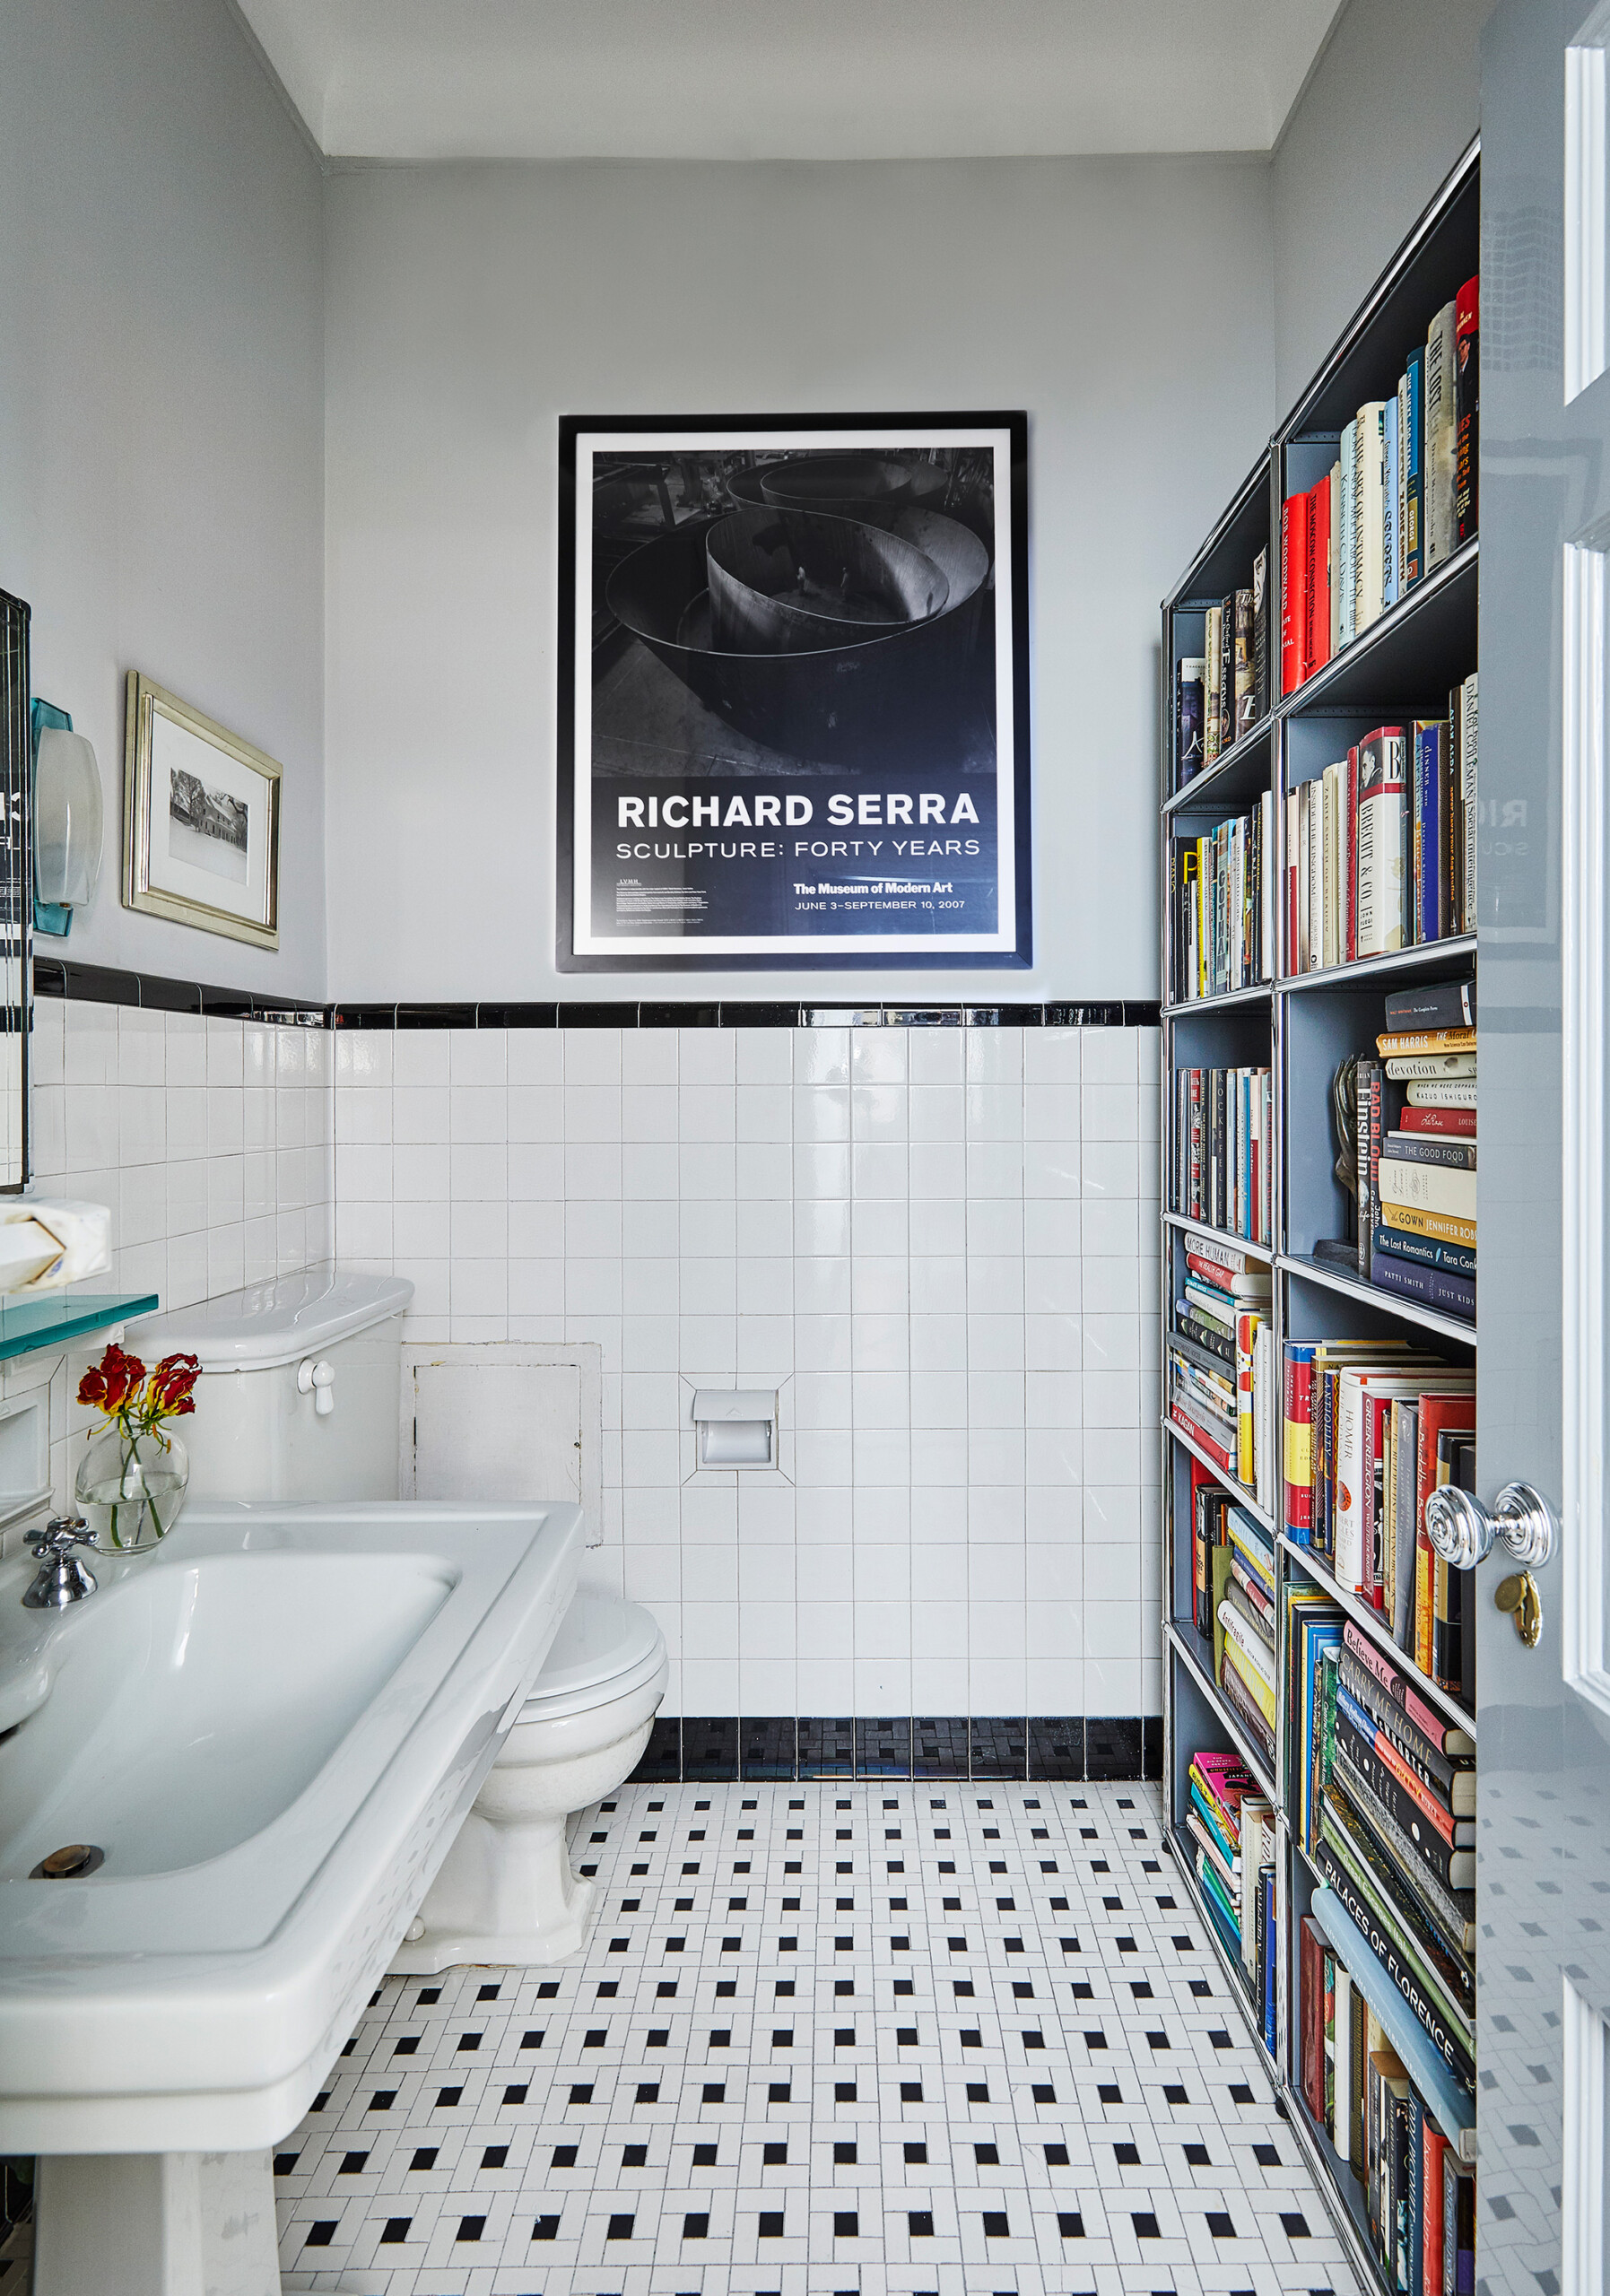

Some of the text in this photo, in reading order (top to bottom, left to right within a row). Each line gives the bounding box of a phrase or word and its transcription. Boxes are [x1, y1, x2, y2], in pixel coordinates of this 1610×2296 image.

[1430, 330, 1442, 411] THE LOST
[1339, 475, 1348, 539] KENNETH
[1355, 432, 1364, 598] THE ART OF INTIMACY
[1308, 493, 1317, 618] THE MOSCOW CONNECTION
[1339, 561, 1348, 604] DAVIS
[1221, 648, 1231, 709] Essays
[618, 792, 980, 828] RICHARD SERRA
[616, 839, 980, 859] SCULPTURE: FORTY YEARS
[1361, 803, 1374, 903] BRECHT & CO.
[794, 882, 953, 895] The Museum of Modern Art
[795, 902, 827, 910] JUNE
[920, 900, 936, 911] 10,
[938, 900, 966, 909] 2007
[1382, 1038, 1398, 1051] SAM
[1399, 1035, 1429, 1048] HARRIS
[1436, 1031, 1448, 1040] THE
[1388, 1061, 1437, 1076] devotion
[1370, 1082, 1380, 1182] BAD BLOOD
[1405, 1145, 1464, 1161] THE GOOD FOOD
[1398, 1213, 1458, 1237] GOWN JENNIFER
[1203, 1261, 1215, 1274] HEALTH
[1215, 1267, 1225, 1279] GAP
[1205, 1244, 1230, 1266] HUMAN
[1379, 1234, 1458, 1265] The Last Romantics Tara
[1384, 1270, 1402, 1283] PATTI
[1403, 1275, 1424, 1290] SMITH
[1438, 1288, 1455, 1300] JUST
[1457, 1293, 1475, 1306] KIDS
[1178, 1412, 1196, 1437] KAGAN
[1324, 1380, 1332, 1457] ANTIQUITY
[1344, 1409, 1354, 1459] HOMER
[1364, 1398, 1372, 1443] GREEK
[1364, 1443, 1372, 1509] RELIGION
[1418, 1431, 1427, 1492] Buddha
[1417, 1495, 1426, 1538] Book
[1223, 1611, 1245, 1648] Antifragile
[1346, 1629, 1389, 1689] Believe Me
[1342, 1652, 1375, 1697] CARRY
[1375, 1694, 1391, 1718] ME
[1393, 1711, 1432, 1769] HOME
[1395, 1763, 1421, 1799] GUTSY
[1343, 1853, 1410, 1961] Great Escapes Italy
[1325, 1859, 1454, 2061] PALACES OF FLORENCE
[1408, 2096, 1417, 2142] JODI
[1408, 2142, 1417, 2224] PICOULT
